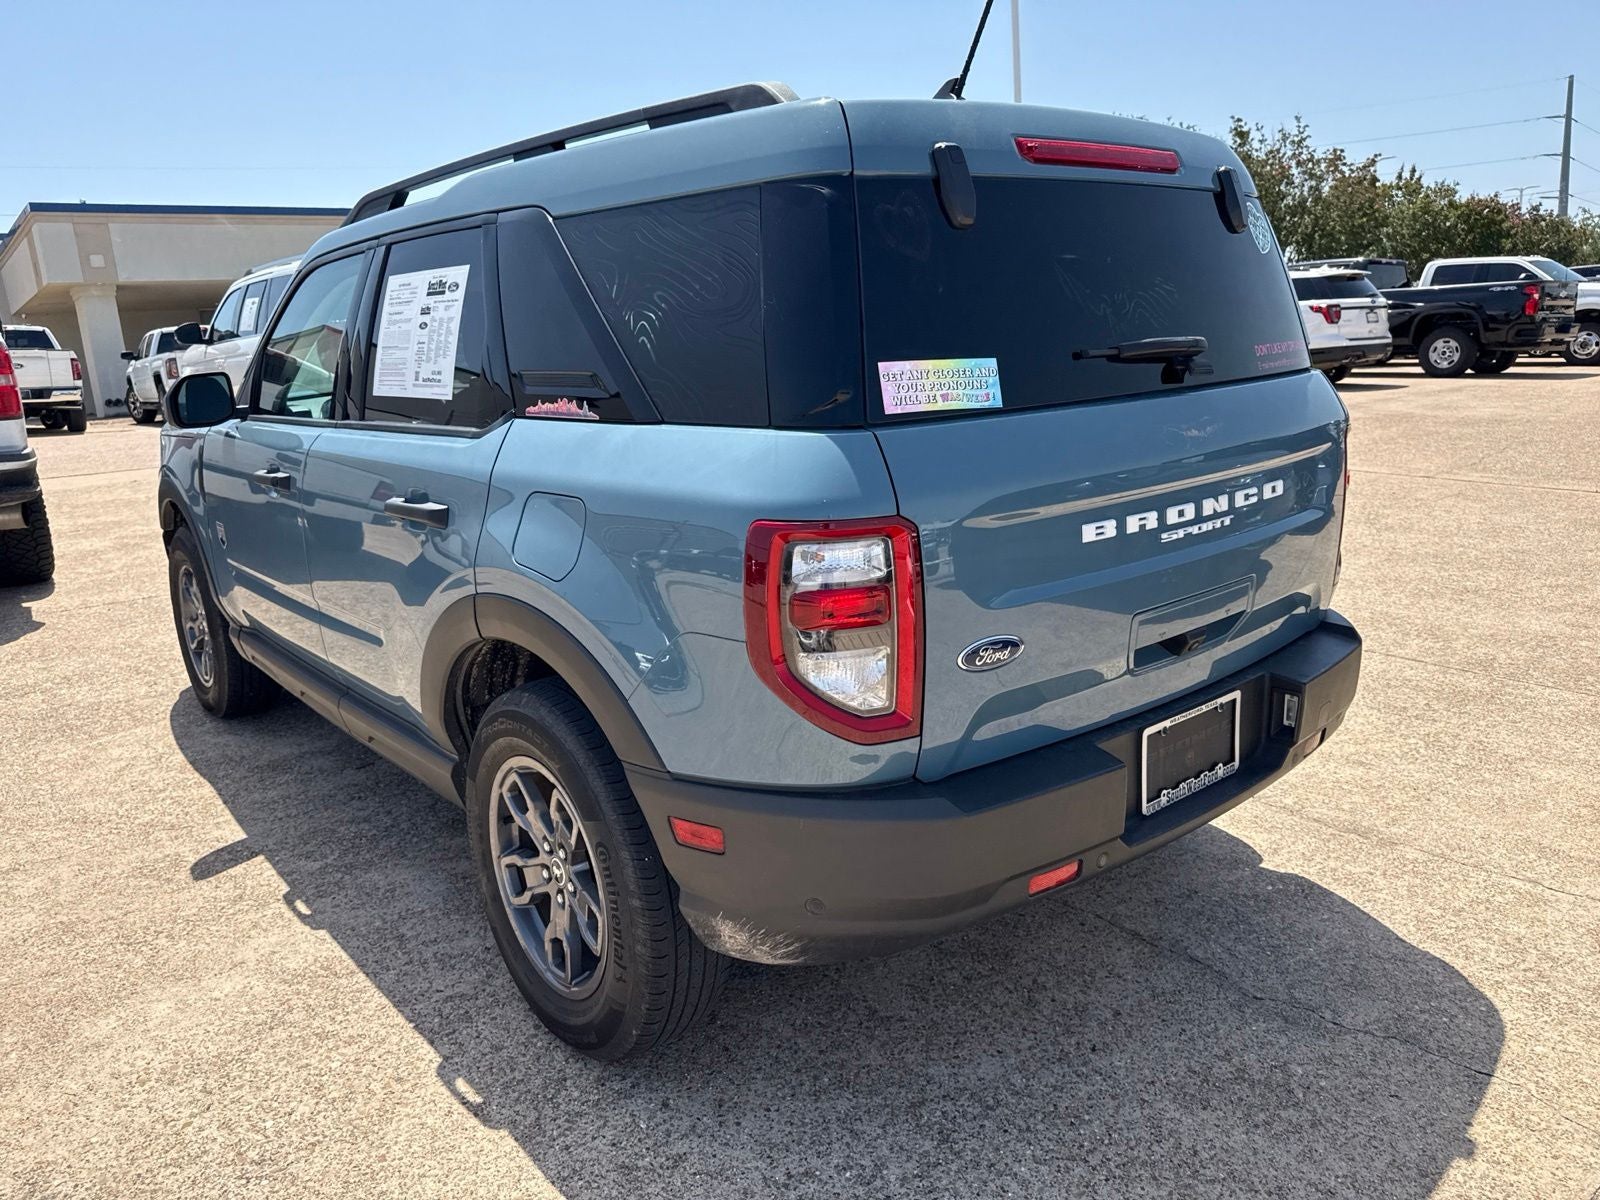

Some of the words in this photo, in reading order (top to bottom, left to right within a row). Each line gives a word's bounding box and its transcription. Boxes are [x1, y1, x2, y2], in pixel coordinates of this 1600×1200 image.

[881, 371, 904, 382] GET
[906, 369, 930, 380] ANY
[931, 368, 974, 379] CLOSER
[975, 367, 998, 377] AND
[892, 382, 926, 393] YOUR
[927, 379, 988, 391] PRONOUNS
[890, 394, 921, 406] WILL
[922, 393, 938, 404] BE
[1081, 479, 1284, 544] BRONCO
[1160, 514, 1235, 543] SPORT
[975, 643, 1012, 666] Ford
[595, 841, 626, 971] Continental
